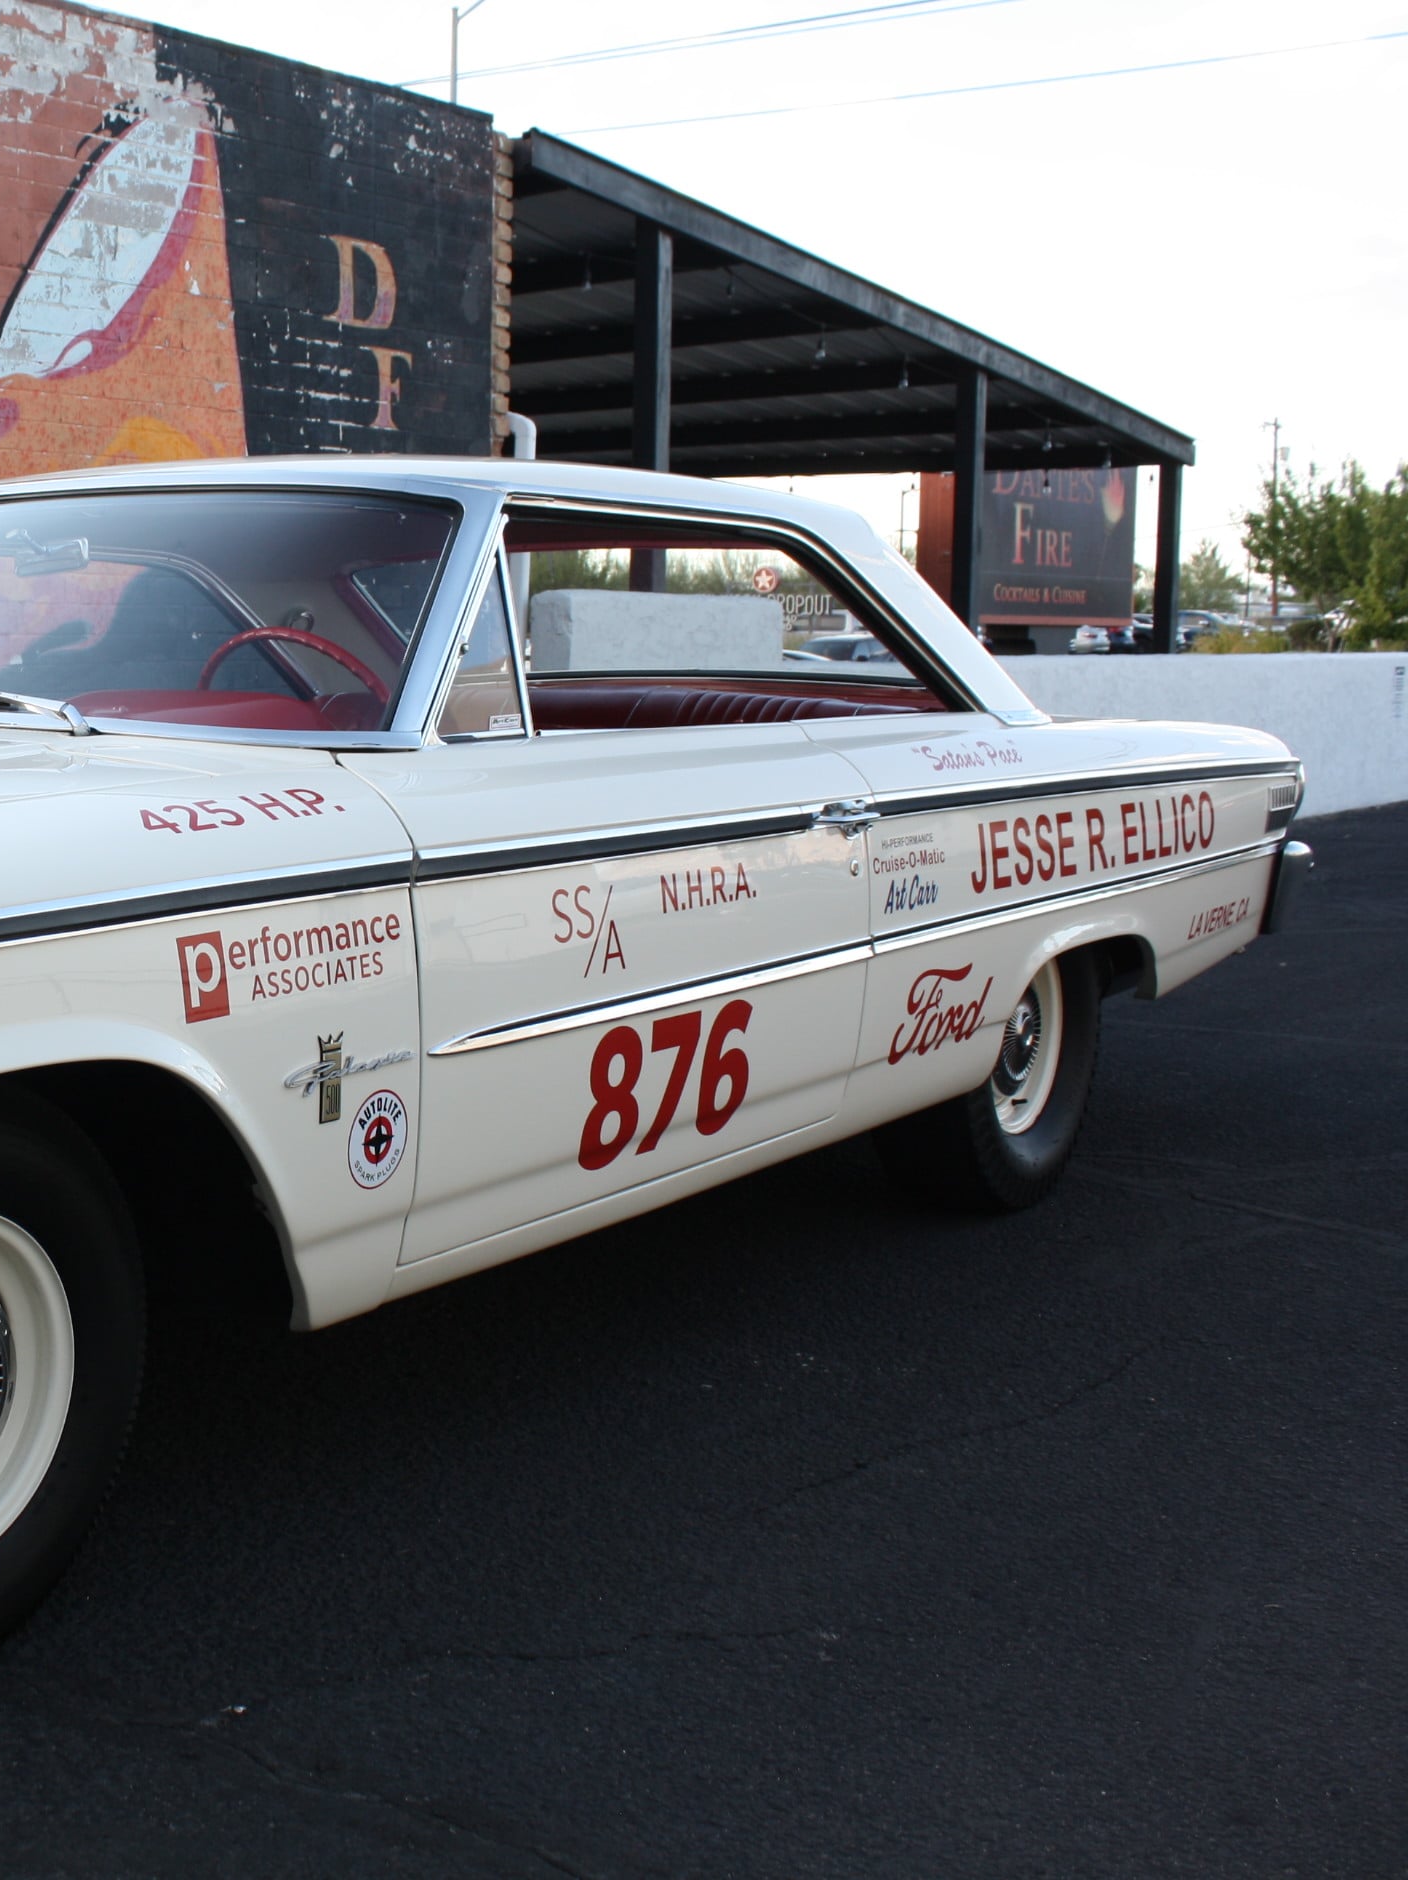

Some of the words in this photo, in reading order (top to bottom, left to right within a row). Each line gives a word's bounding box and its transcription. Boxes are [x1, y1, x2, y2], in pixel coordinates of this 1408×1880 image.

[323, 234, 397, 330] D
[360, 345, 413, 431] F
[139, 799, 245, 834] 425
[238, 788, 346, 821] H.P.
[873, 848, 945, 874] Cruise-O-Matic
[881, 833, 934, 849] HI-PERFORMANCE
[971, 811, 1077, 894] JESSE
[1085, 807, 1116, 872] R.
[1120, 791, 1214, 865] ELLICO
[660, 862, 756, 914] N.H.R.A.
[884, 877, 907, 914] Art
[908, 874, 938, 911] Carr
[251, 950, 385, 1001] ASSOCIATES
[887, 962, 994, 1066] Ford
[326, 1083, 341, 1116] 500
[578, 999, 753, 1171] 876
[357, 1097, 403, 1131] AUTOLITE
[353, 1160, 376, 1182] SPARK
